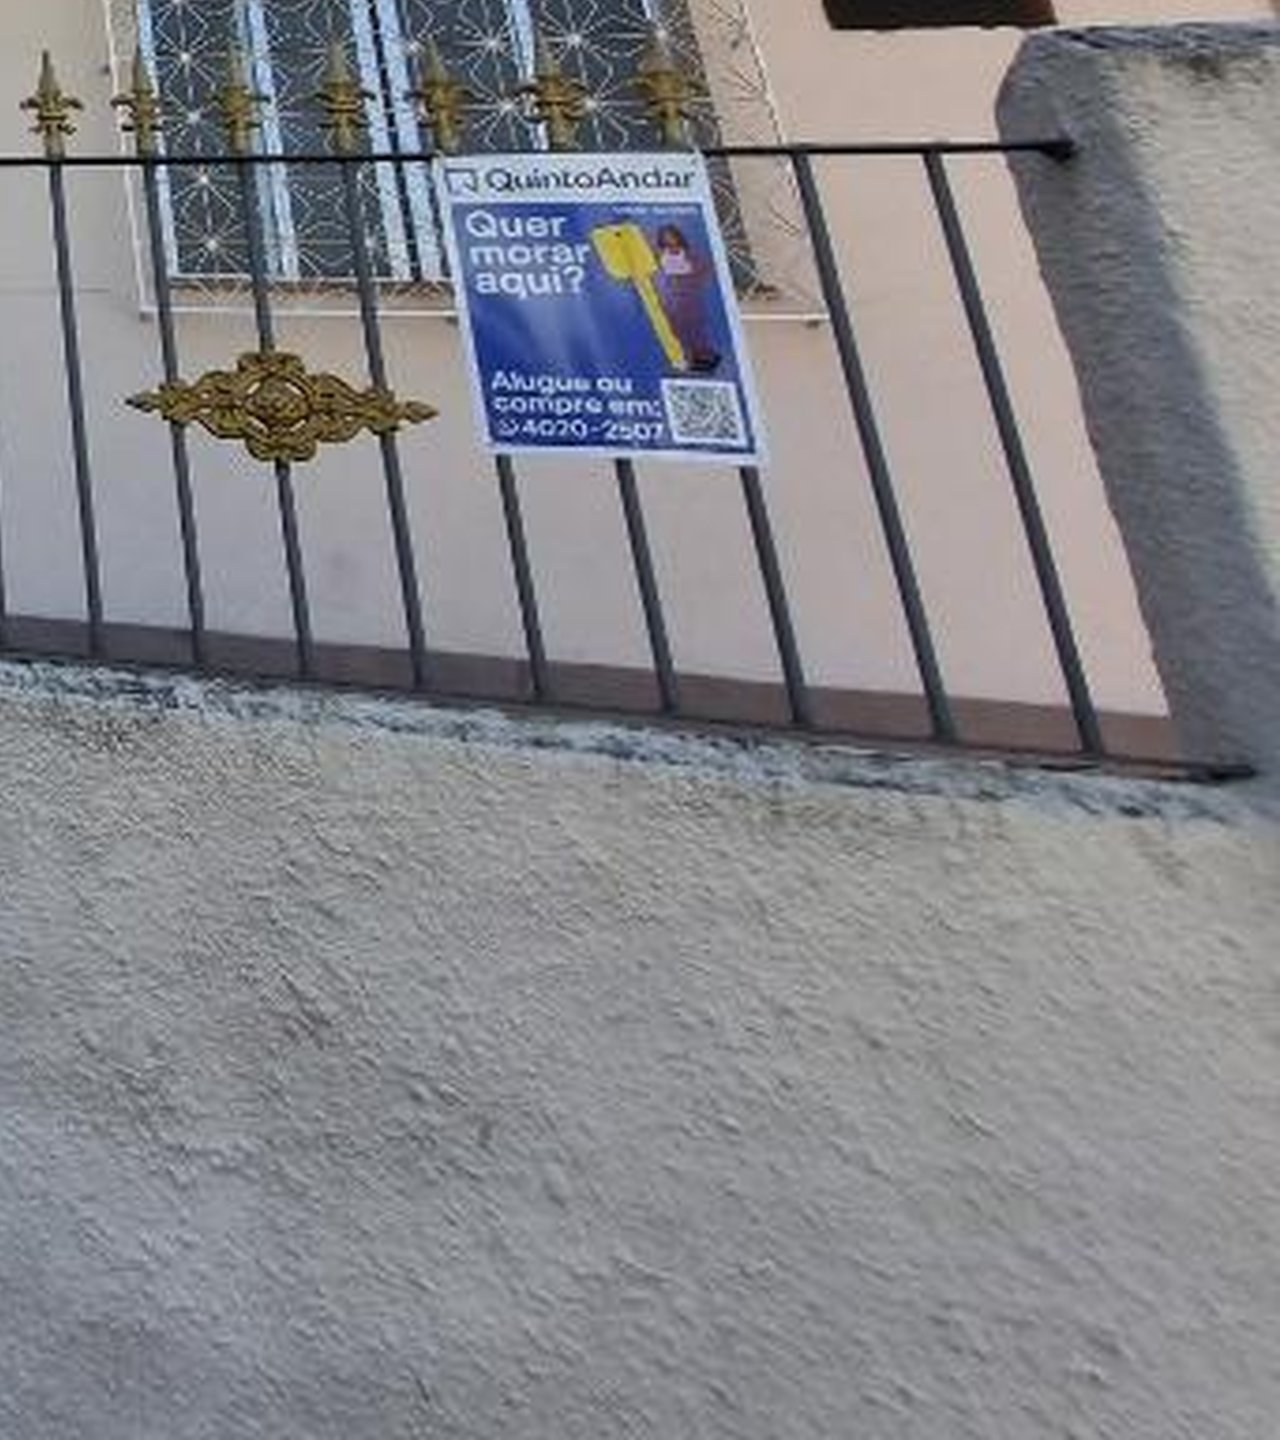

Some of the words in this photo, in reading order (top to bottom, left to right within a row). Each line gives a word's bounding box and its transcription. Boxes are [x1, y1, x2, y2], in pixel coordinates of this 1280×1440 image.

[486, 167, 697, 192] QuintoAndar
[465, 210, 567, 237] Quer
[470, 242, 591, 266] morar
[475, 268, 586, 299] aqui?
[491, 371, 591, 394] Alugue
[596, 376, 633, 393] ou
[493, 396, 603, 418] compre
[608, 400, 663, 417] em:
